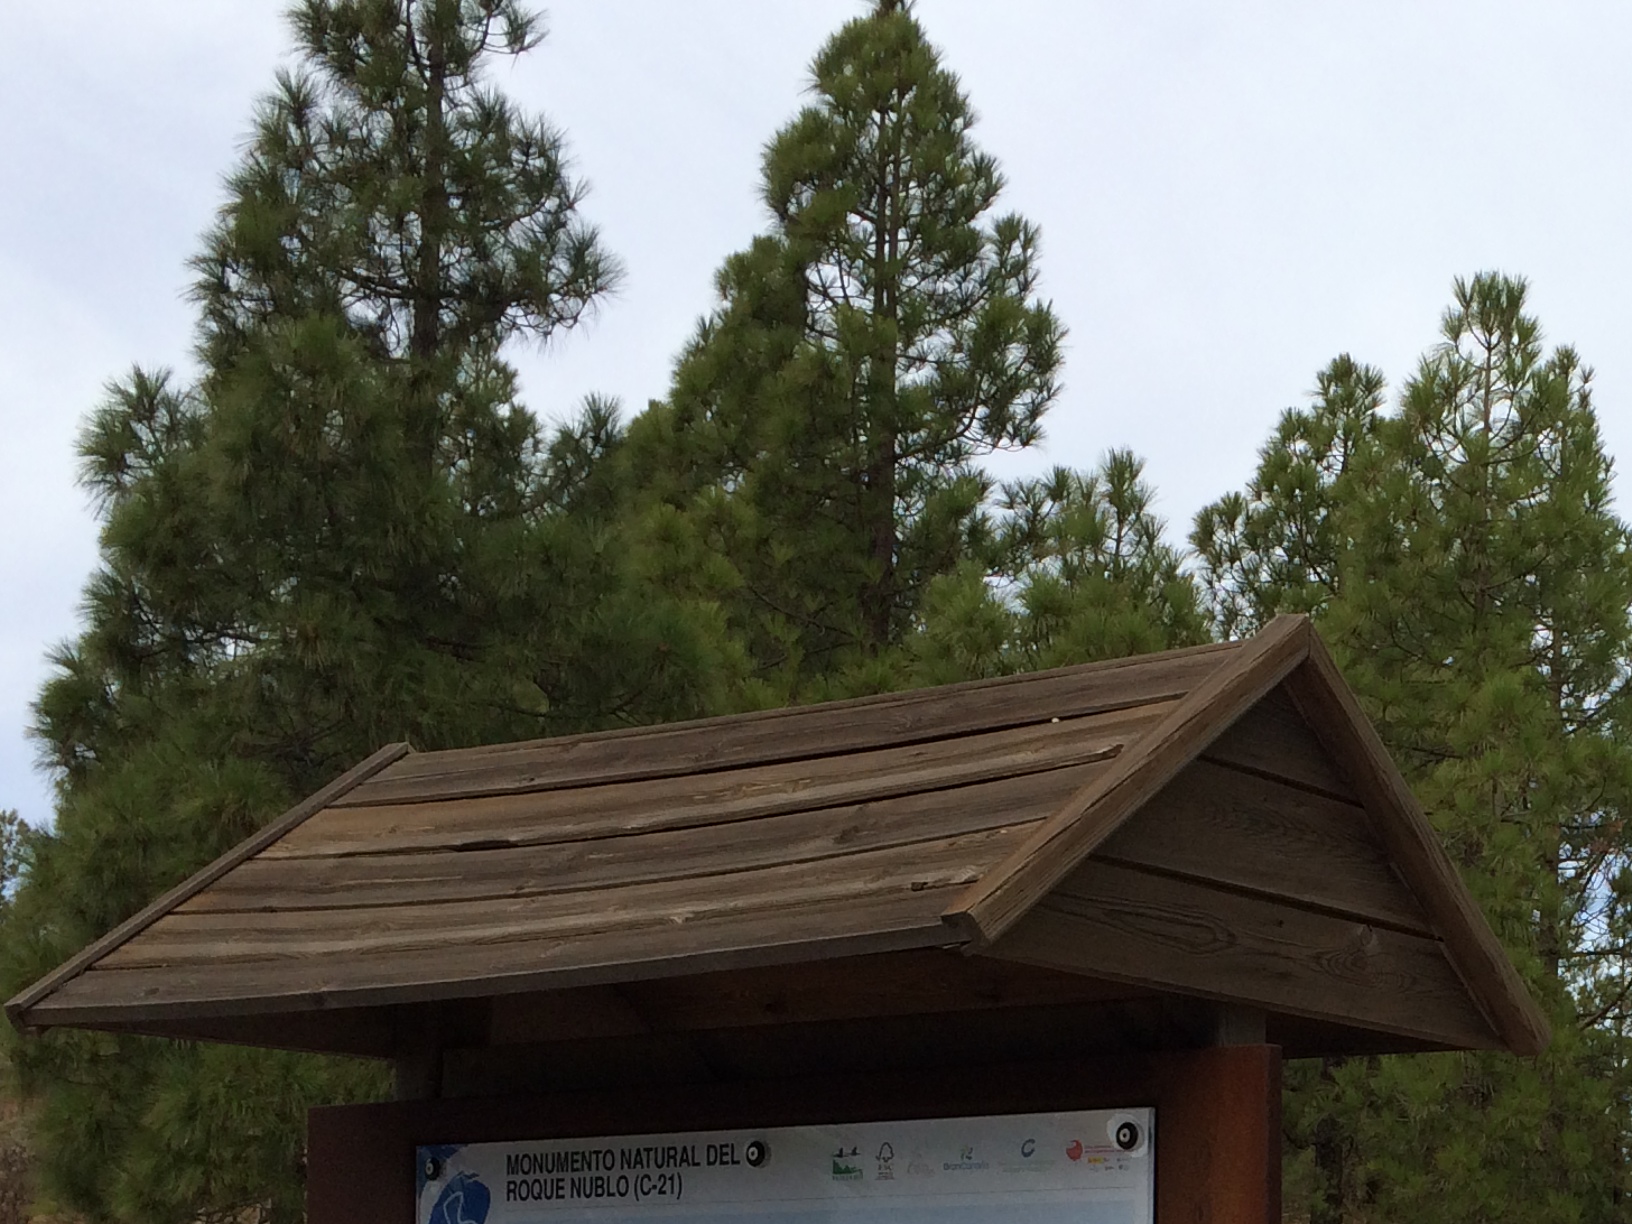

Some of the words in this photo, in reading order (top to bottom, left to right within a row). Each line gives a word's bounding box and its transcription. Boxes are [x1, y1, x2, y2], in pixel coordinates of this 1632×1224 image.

[506, 1149, 616, 1176] MONUMENTO
[620, 1145, 701, 1170] NATURAL
[706, 1143, 741, 1166] DEL
[506, 1178, 565, 1202] ROQUE
[570, 1175, 629, 1198] NUBLO
[634, 1172, 683, 1201] (C-21)
